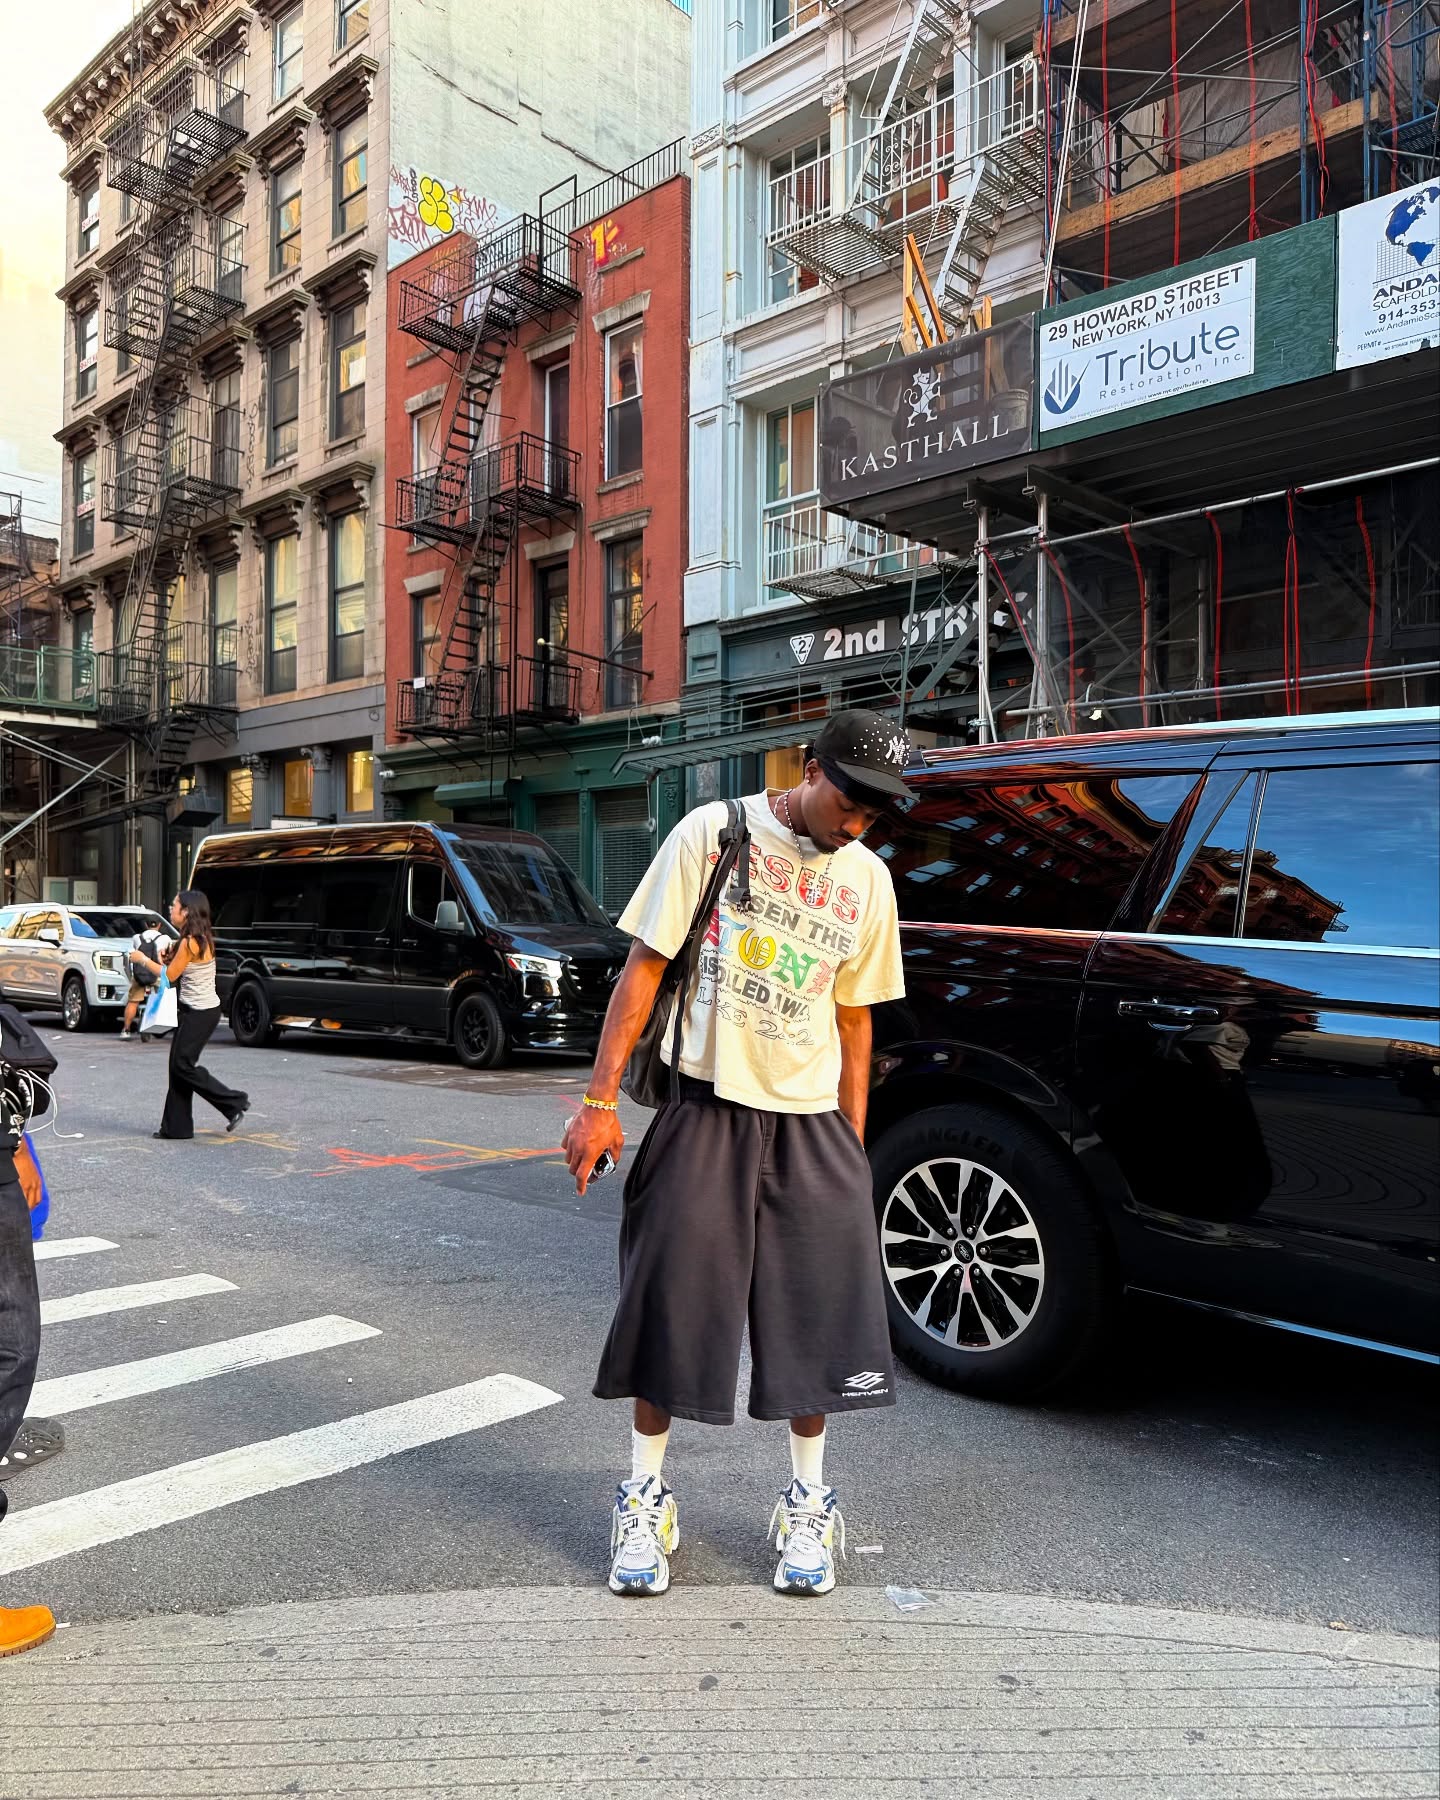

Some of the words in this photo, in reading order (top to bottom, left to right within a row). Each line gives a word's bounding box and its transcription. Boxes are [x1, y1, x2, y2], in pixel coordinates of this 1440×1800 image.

[1049, 323, 1067, 342] 29
[1073, 295, 1156, 334] HOWARD
[1163, 266, 1243, 304] STREET
[1373, 274, 1440, 301] ANDA
[1373, 285, 1440, 311] SCAFFOLD
[1072, 331, 1103, 349] NEW
[1107, 315, 1151, 339] YORK,
[1155, 307, 1175, 324] NY
[1179, 292, 1221, 315] 10013
[1364, 312, 1440, 337] www.AndamioSca
[1378, 300, 1440, 324] 914-353-
[1096, 322, 1240, 386] Tribute
[1099, 364, 1202, 400] Restoration
[1214, 353, 1245, 367] Inc.
[841, 414, 1009, 481] KASTHALL
[823, 619, 885, 661] 2nd
[901, 591, 1032, 647] STR
[706, 843, 861, 925] ESUS
[748, 894, 801, 932] SEN
[808, 920, 852, 956] THE
[697, 986, 748, 1029] LKE
[842, 1388, 889, 1398] HEAVEN
[630, 1577, 642, 1589] 46
[795, 1576, 807, 1589] 46
